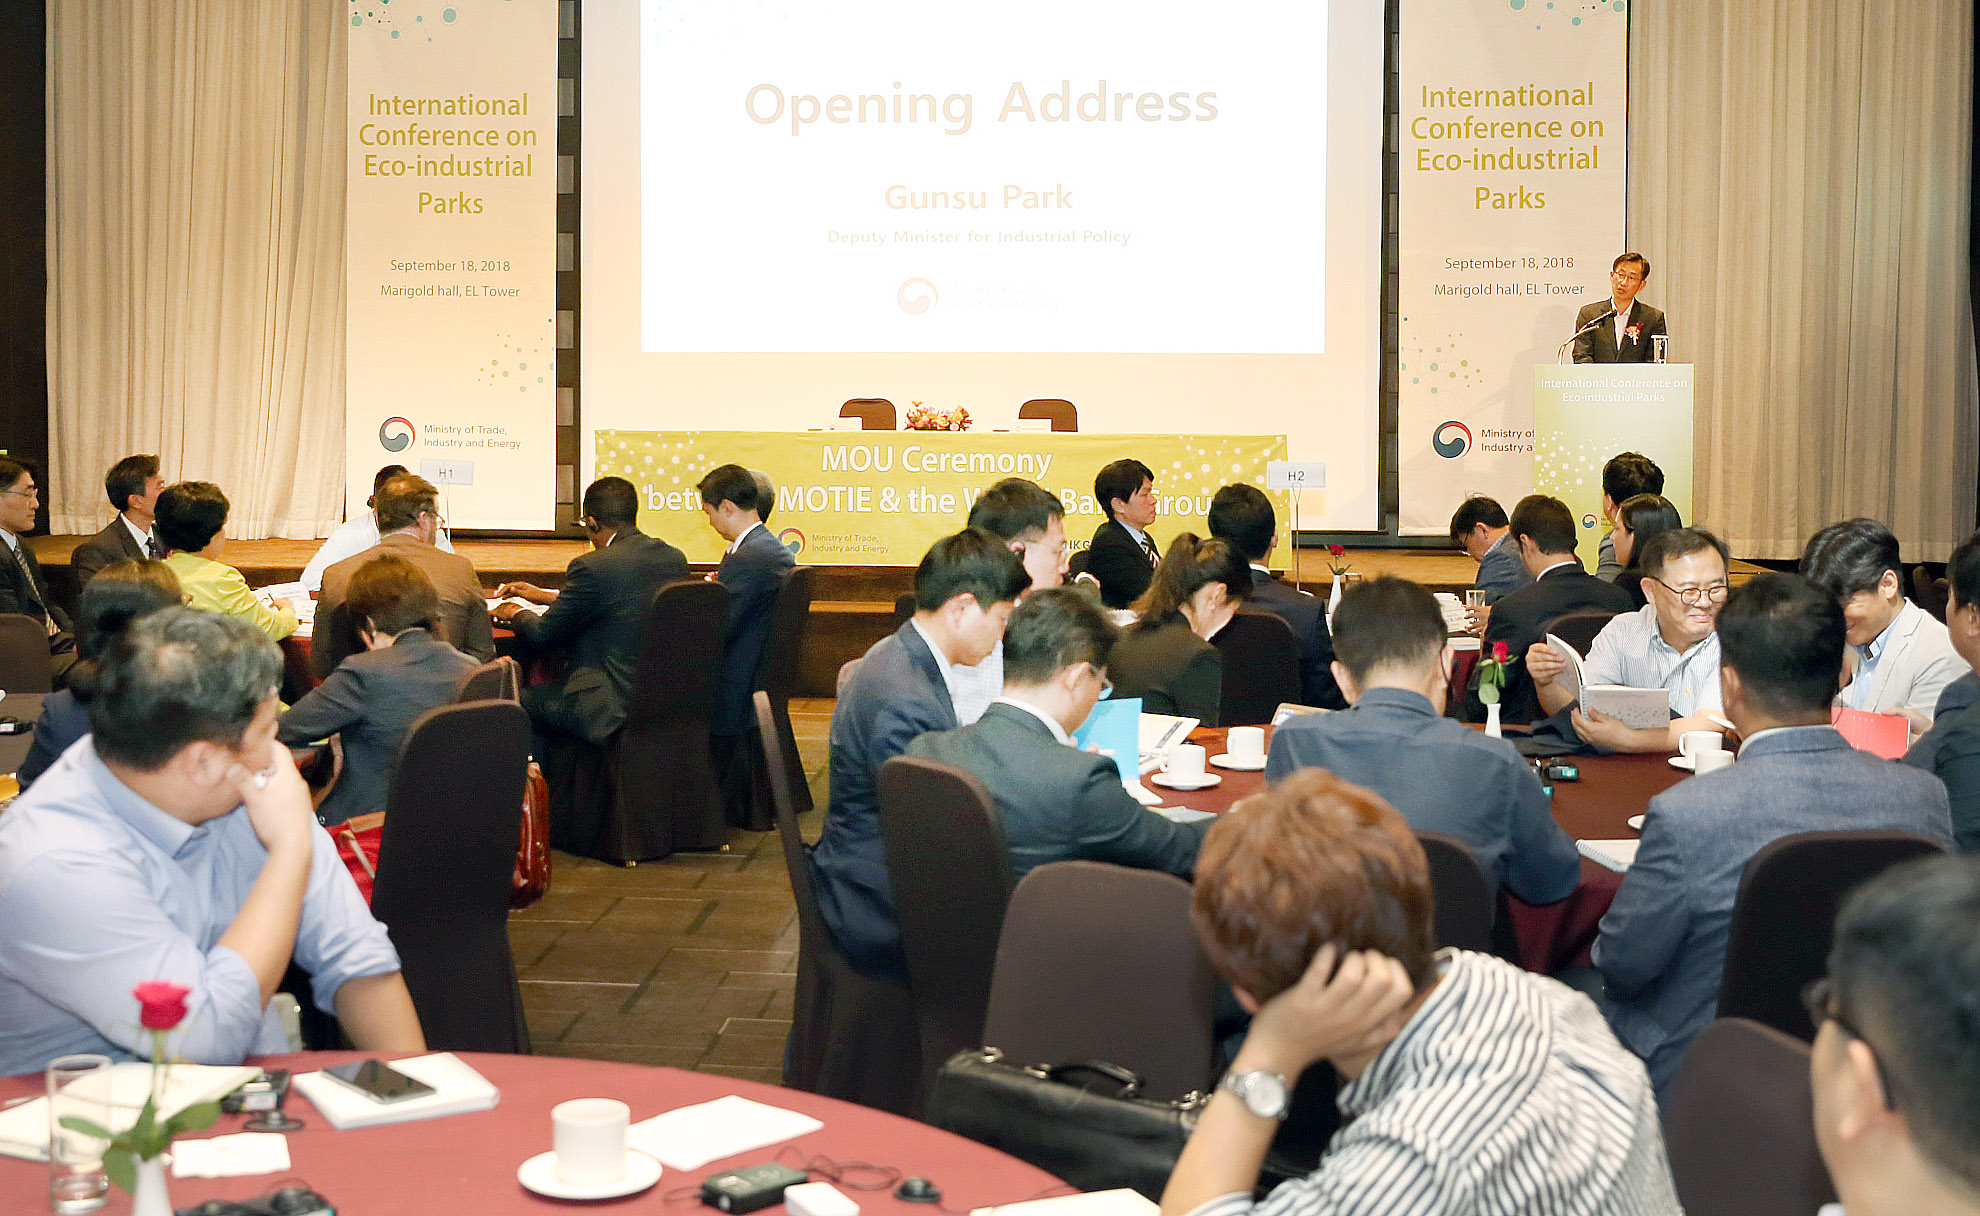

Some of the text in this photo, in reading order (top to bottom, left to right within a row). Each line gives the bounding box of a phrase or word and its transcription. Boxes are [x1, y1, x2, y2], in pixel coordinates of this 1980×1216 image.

[1422, 81, 1594, 108] International
[369, 92, 529, 116] International
[744, 79, 1219, 137] Opening Address
[359, 122, 538, 147] Conference on
[1411, 114, 1605, 140] Conference on
[364, 153, 533, 177] Eco-industrial
[1416, 144, 1599, 171] Eco-industrial
[417, 191, 484, 215] Parks
[884, 183, 1074, 210] Gunsu Park
[1474, 184, 1546, 210] Parks
[827, 229, 1132, 247] Deputy Minister for Industrial Policy
[390, 259, 511, 274] September 18, 2018
[1444, 256, 1575, 272] September 18, 2018
[381, 284, 521, 299] Marigold hall, EL Tower
[1434, 282, 1585, 298] Marigold hall, EL Tower
[1541, 377, 1688, 388] International Conference on
[1562, 392, 1665, 402] Eco-industrial Parks
[424, 425, 508, 435] Ministry of Trade,
[1481, 428, 1523, 440] Ministry
[424, 439, 521, 449] Industry and Energy
[1481, 442, 1524, 453] Industry
[821, 444, 1052, 481] MOU Ceremony
[438, 468, 453, 478] H1
[1287, 470, 1306, 482] H2
[779, 486, 873, 513] MOTIE
[879, 486, 901, 513] &
[907, 485, 956, 513] the
[812, 534, 843, 543] Ministry
[855, 534, 879, 542] Trade,
[812, 544, 844, 552] Industry
[862, 545, 888, 553] Energy
